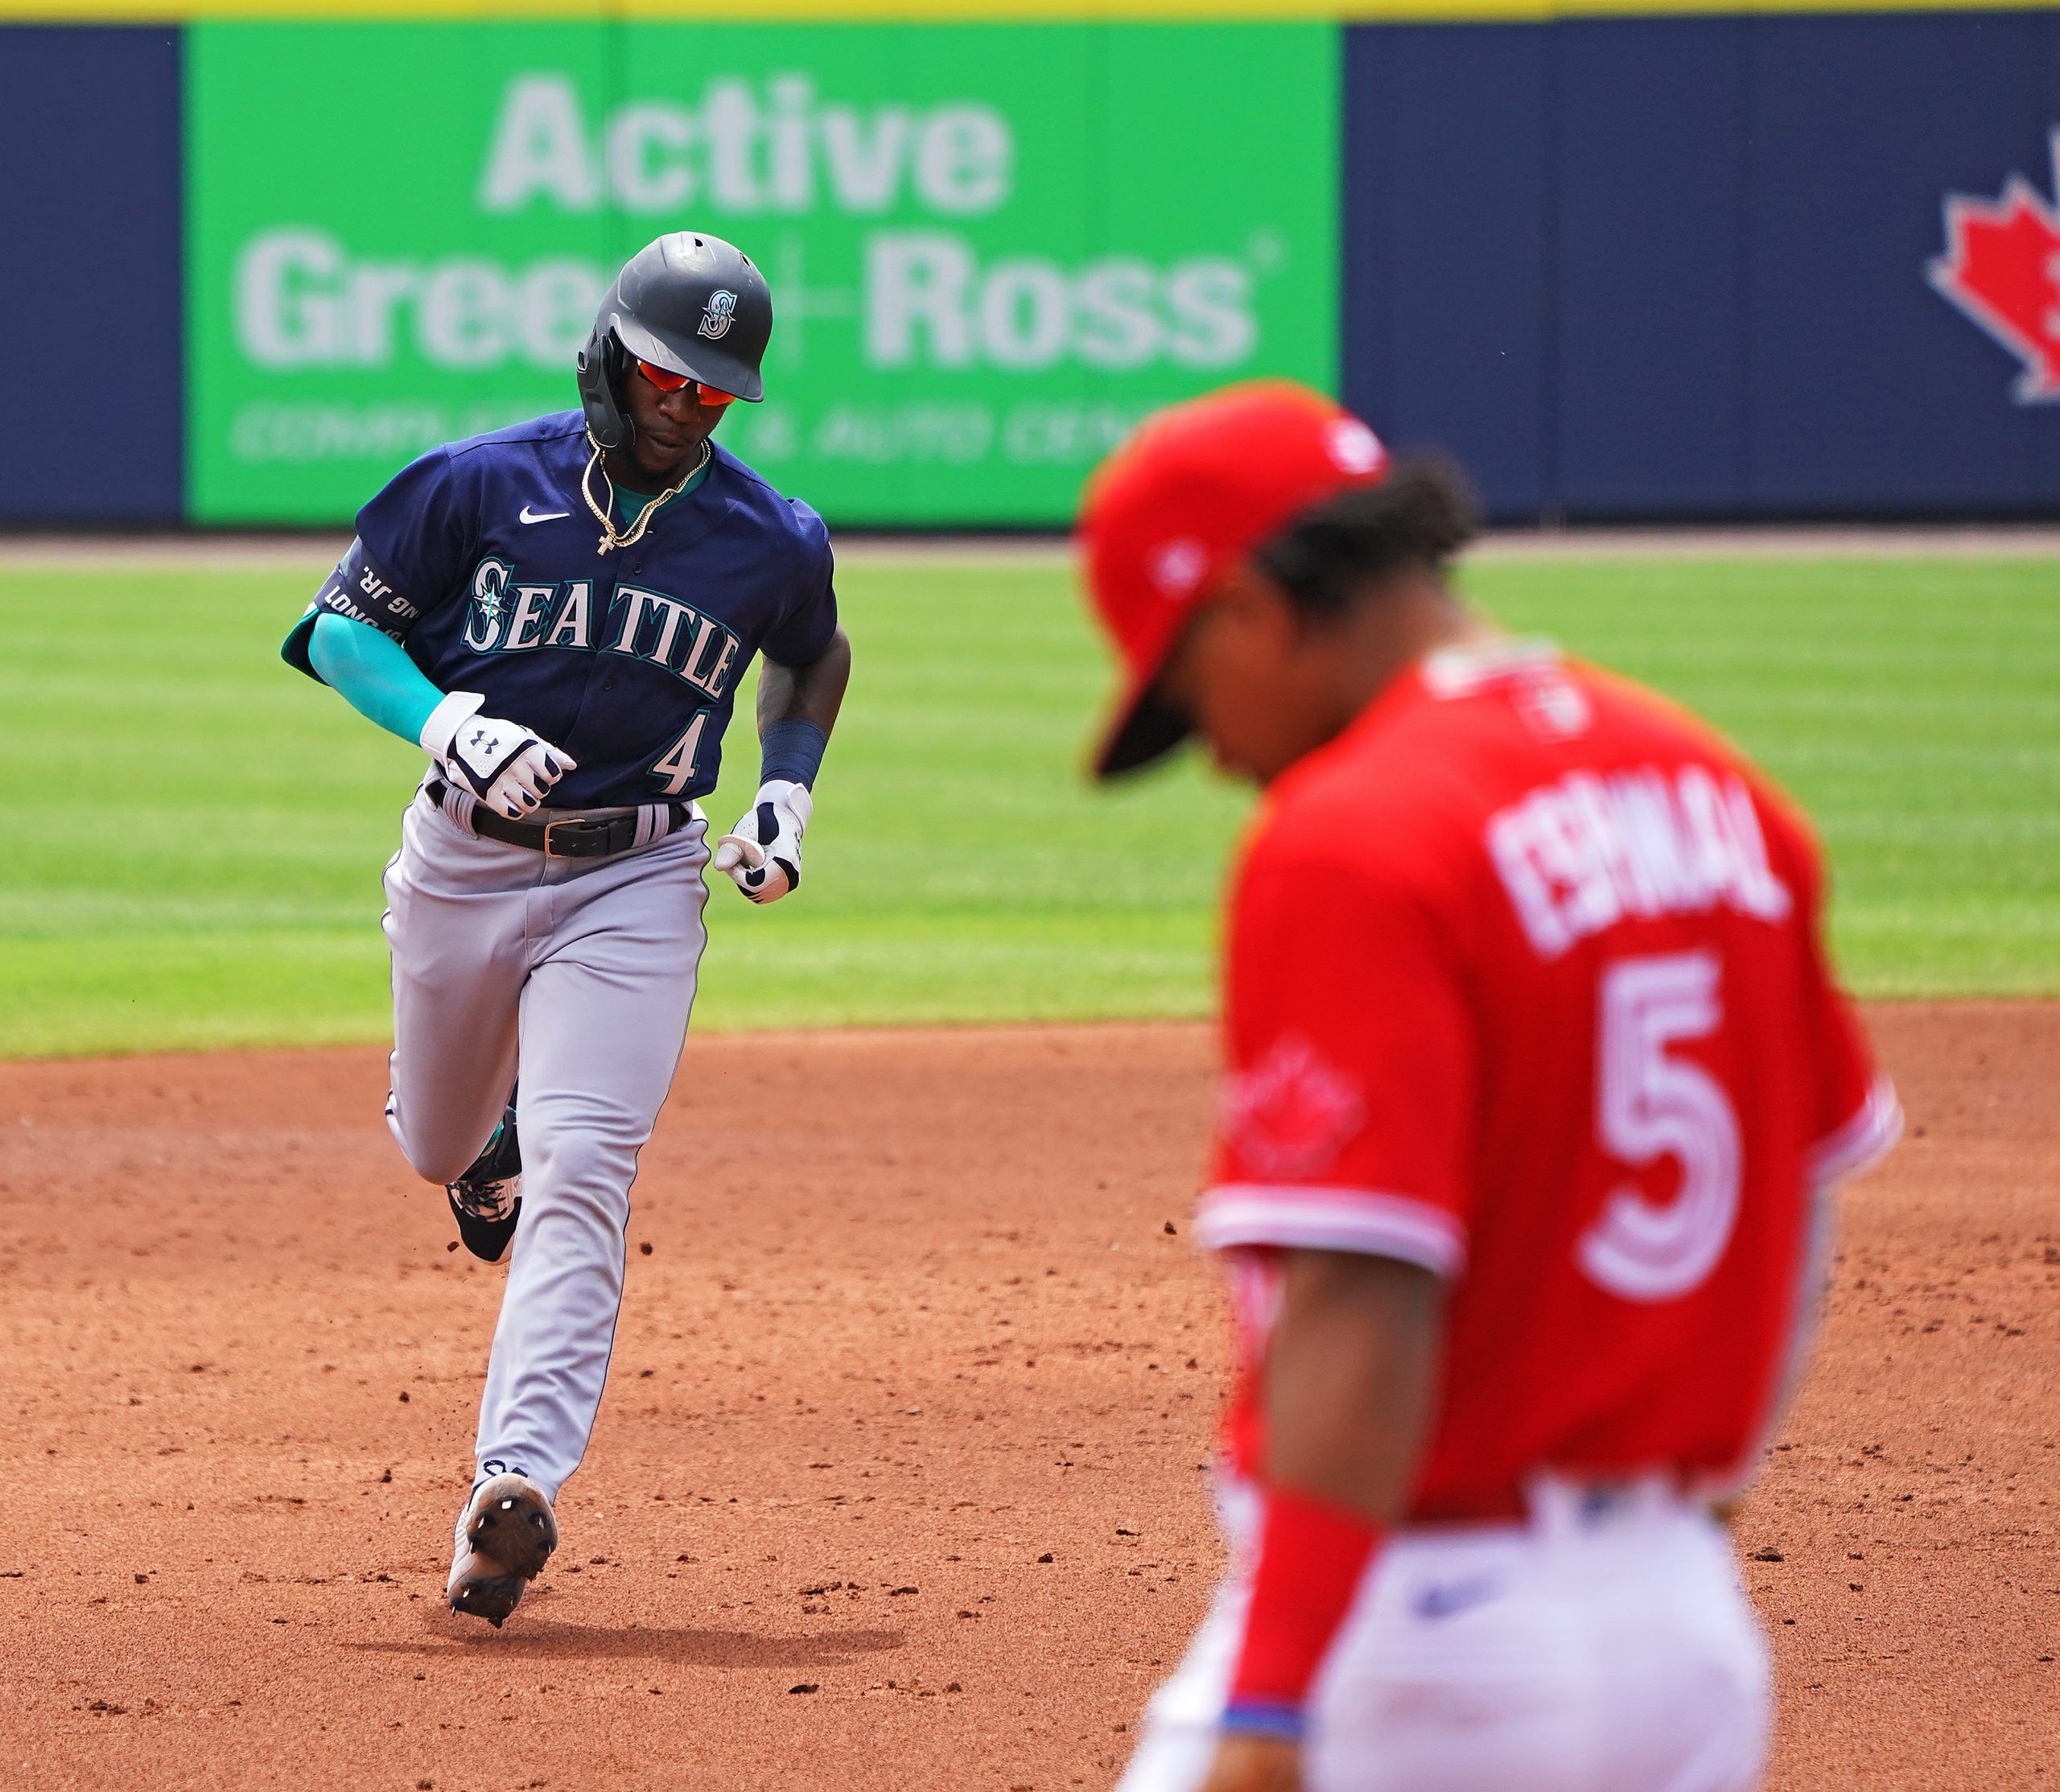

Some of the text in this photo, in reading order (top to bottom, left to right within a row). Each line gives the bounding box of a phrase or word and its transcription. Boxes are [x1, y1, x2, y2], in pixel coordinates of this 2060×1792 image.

[480, 74, 1016, 216] Active
[235, 229, 597, 370] Gree
[864, 231, 1258, 370] Ross
[360, 566, 393, 600] JR.
[461, 557, 740, 702] SEATTLE
[648, 709, 711, 796] 4
[1577, 954, 1745, 1304] 5
